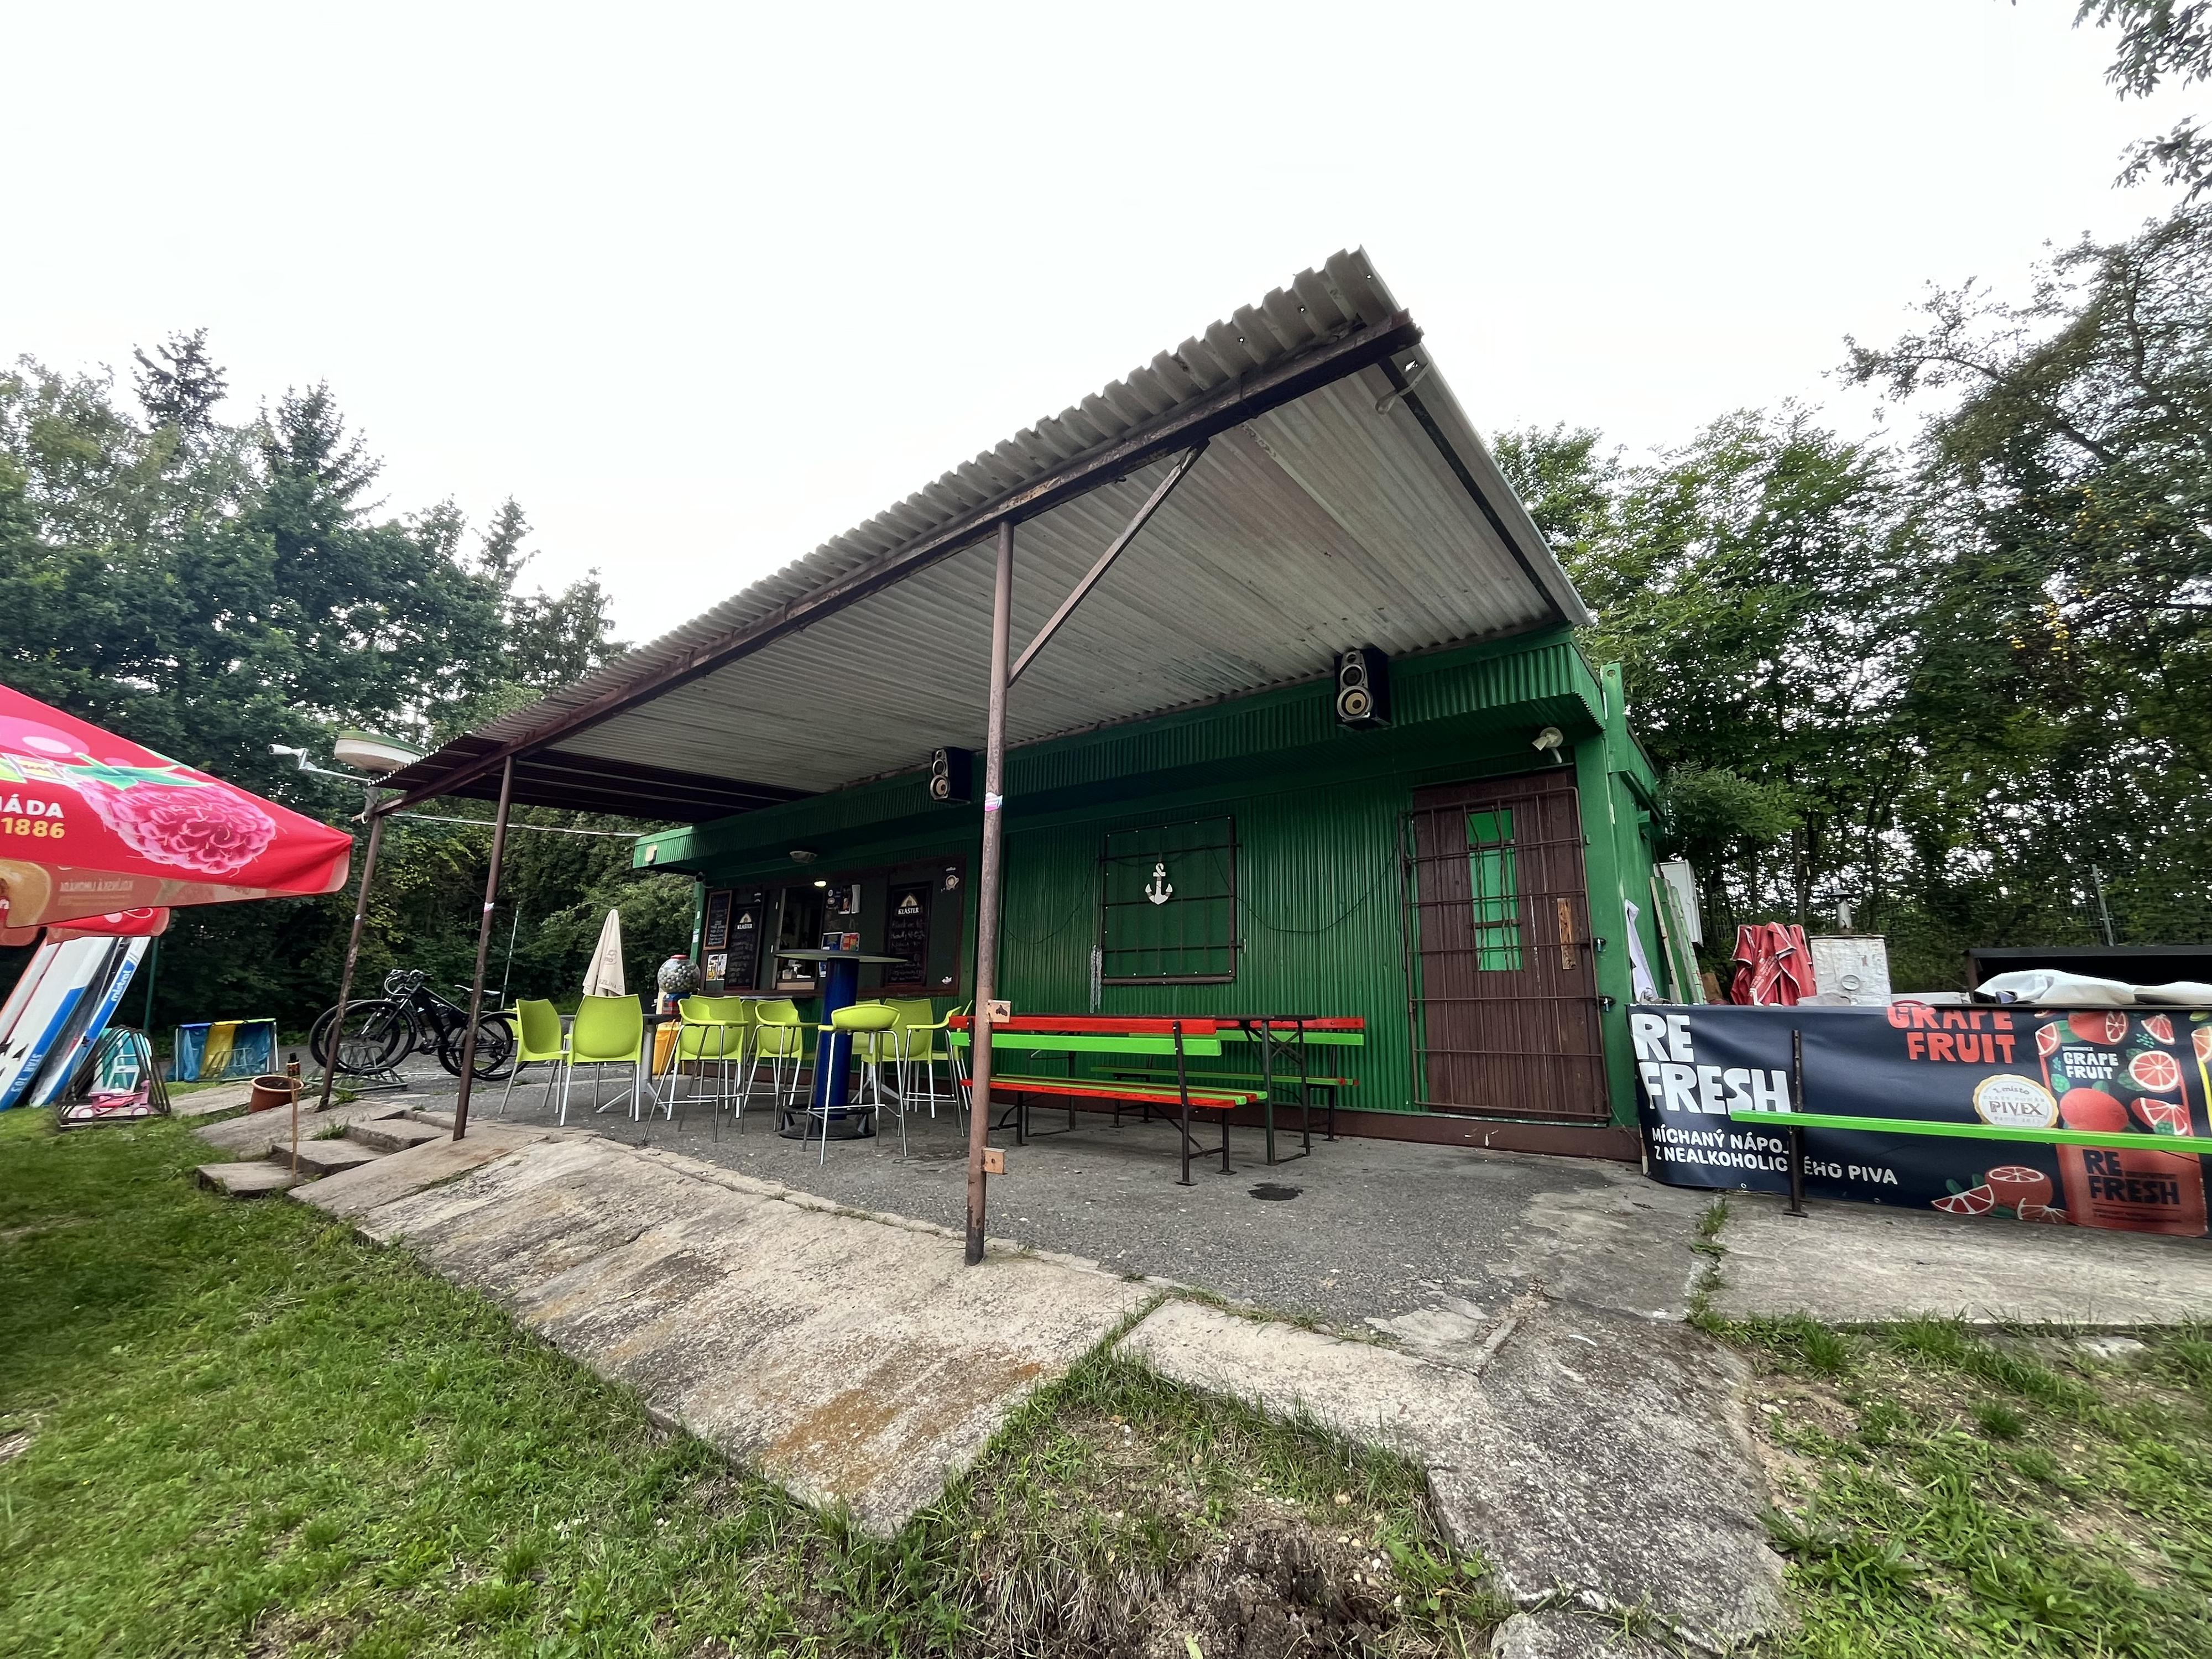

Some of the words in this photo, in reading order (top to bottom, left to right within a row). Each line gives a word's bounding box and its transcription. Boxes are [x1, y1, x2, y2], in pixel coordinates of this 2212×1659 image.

[1, 817, 65, 838] 1886
[111, 970, 132, 1002] mistral
[1886, 1006, 2013, 1030] GRAPE
[1631, 1013, 1694, 1062] RE
[1906, 1032, 2016, 1063] FRUIT
[2062, 1052, 2119, 1066] GRAPE
[2065, 1065, 2114, 1079] FRUIT
[1639, 1062, 1792, 1116] FRESH
[1989, 1100, 2045, 1116] PIVEX
[1652, 1124, 1725, 1148] MÍCHANÝ
[1654, 1146, 1662, 1160] Z
[1664, 1146, 1843, 1178] NEALKOHOLICÉHO
[1848, 1165, 1898, 1185] PIVA
[2083, 1149, 2122, 1177] RE
[2089, 1176, 2180, 1205] FRESH
